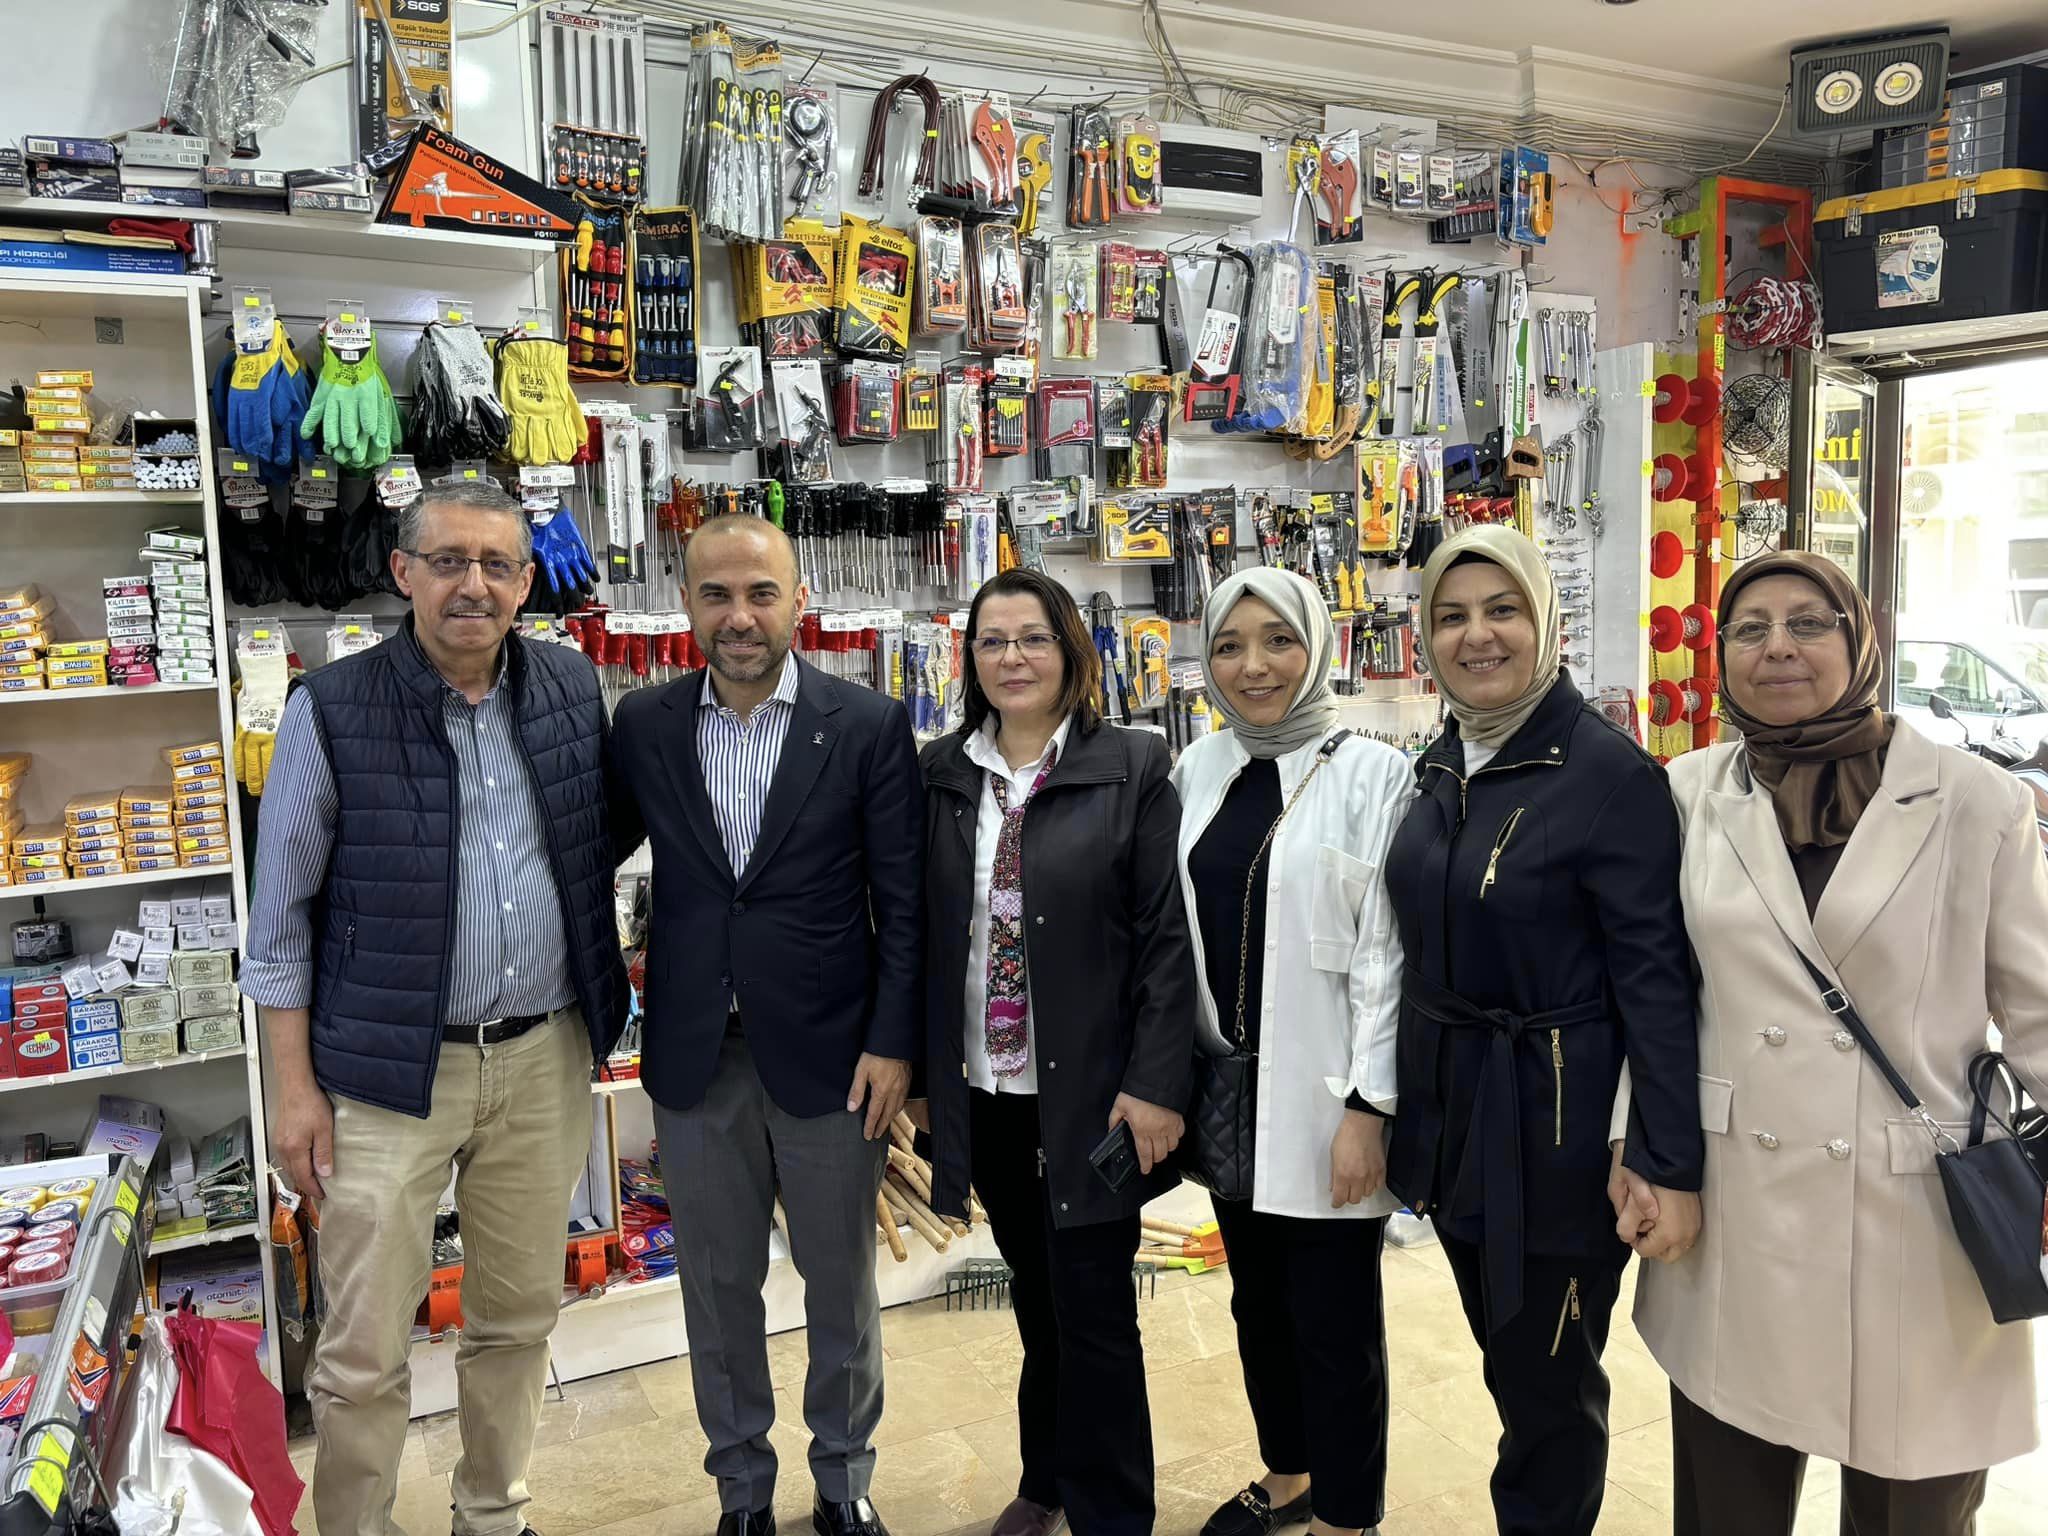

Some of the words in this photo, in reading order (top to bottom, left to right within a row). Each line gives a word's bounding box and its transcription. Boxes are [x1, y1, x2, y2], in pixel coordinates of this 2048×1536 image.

[407, 0, 442, 13] SGS
[556, 12, 600, 29] BAY-TEC
[422, 40, 449, 49] PLATING
[425, 130, 470, 161] Foam
[472, 155, 505, 181] Gun
[530, 475, 552, 484] 90.00
[614, 621, 634, 630] 60.00
[188, 797, 205, 806] 151R
[133, 803, 150, 811] 151R
[78, 811, 97, 820] 151R
[186, 812, 203, 821] 151R
[79, 826, 95, 836] 151R
[137, 832, 154, 841] 151R
[25, 843, 43, 852] 151R
[83, 840, 101, 849] 151R
[137, 846, 154, 855] 151R
[80, 853, 98, 862] 151R
[87, 866, 105, 875] 151R
[27, 873, 45, 881] 151R
[74, 1003, 112, 1014] KARAKOÇ
[76, 1036, 114, 1048] KARAKOÇ
